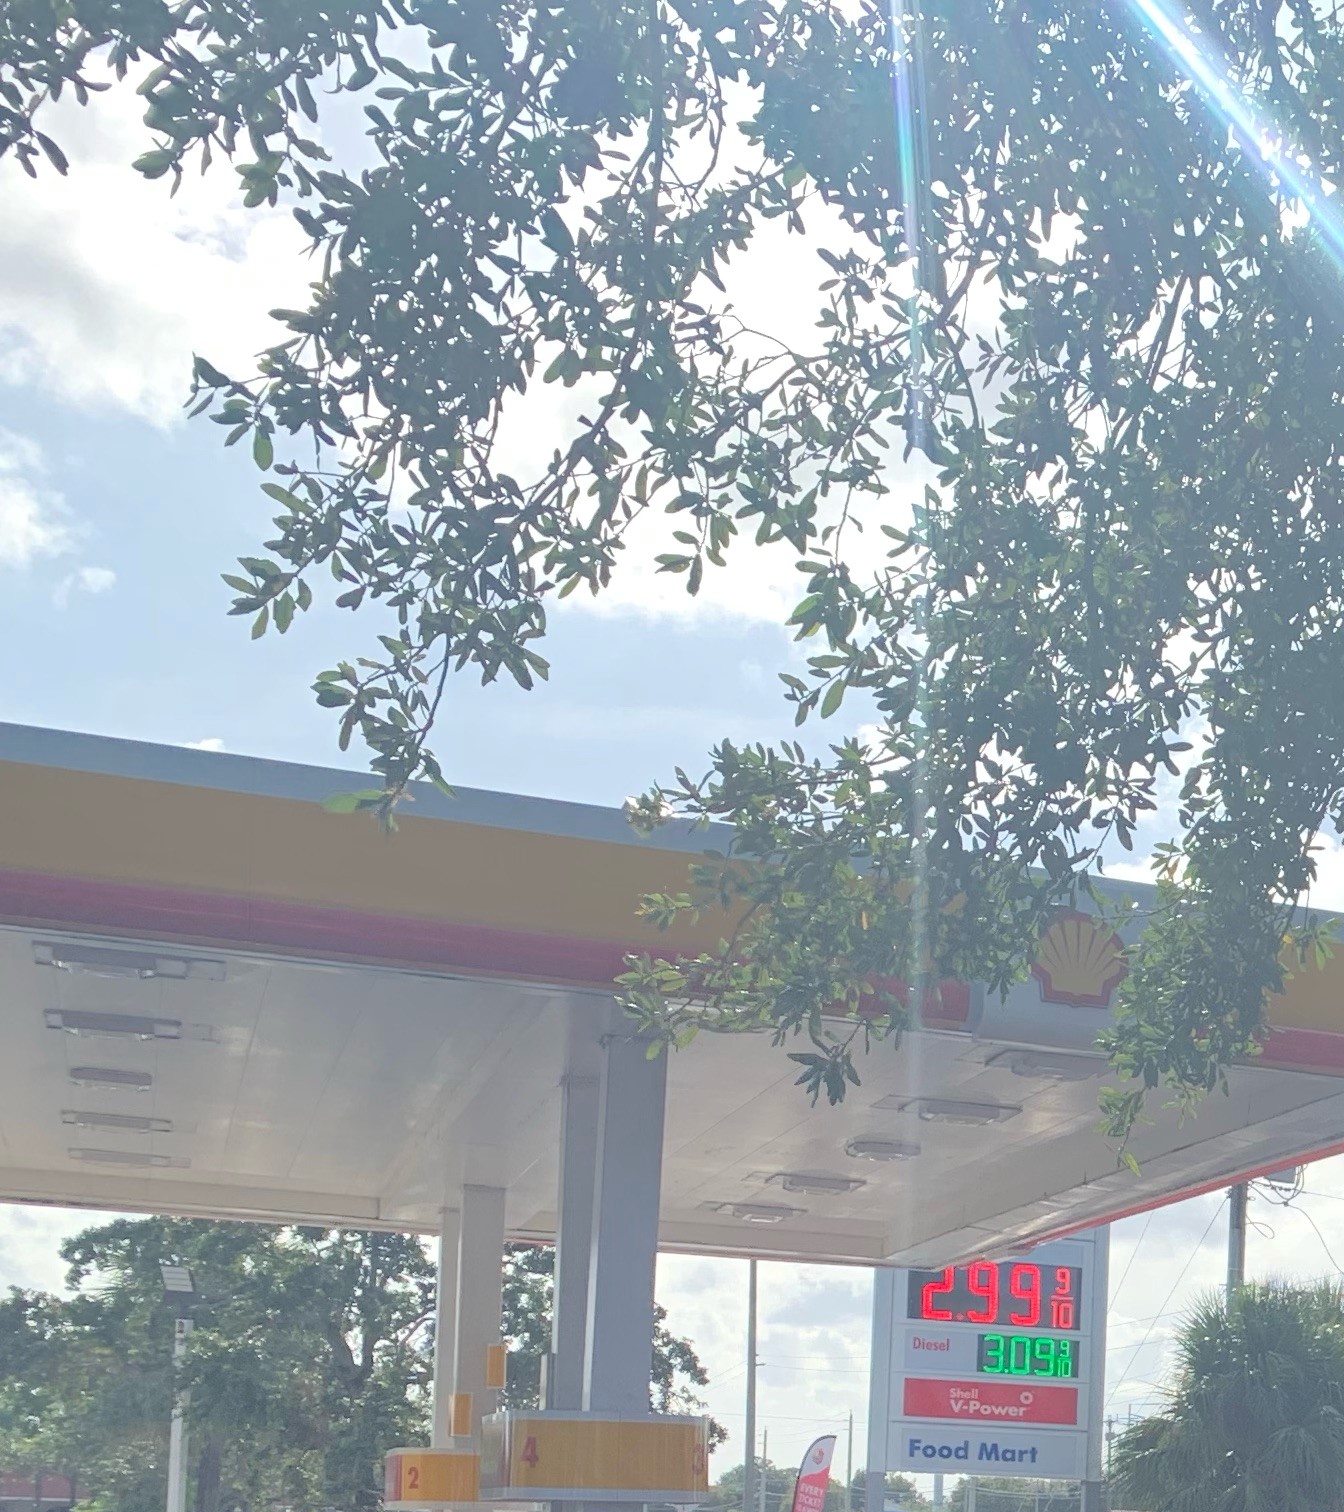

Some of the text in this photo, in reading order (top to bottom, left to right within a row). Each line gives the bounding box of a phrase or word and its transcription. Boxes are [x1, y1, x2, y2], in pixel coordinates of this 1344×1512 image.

[921, 1261, 1041, 1326] 2.99
[912, 1336, 950, 1352] Diesel
[982, 1334, 1054, 1376] 3.09
[950, 1388, 979, 1400] Shell
[950, 1400, 1026, 1417] V-Power
[522, 1437, 539, 1468] 4
[908, 1438, 1038, 1463] Food Mart
[407, 1466, 420, 1489] 2
[800, 1483, 824, 1498] EVERY
